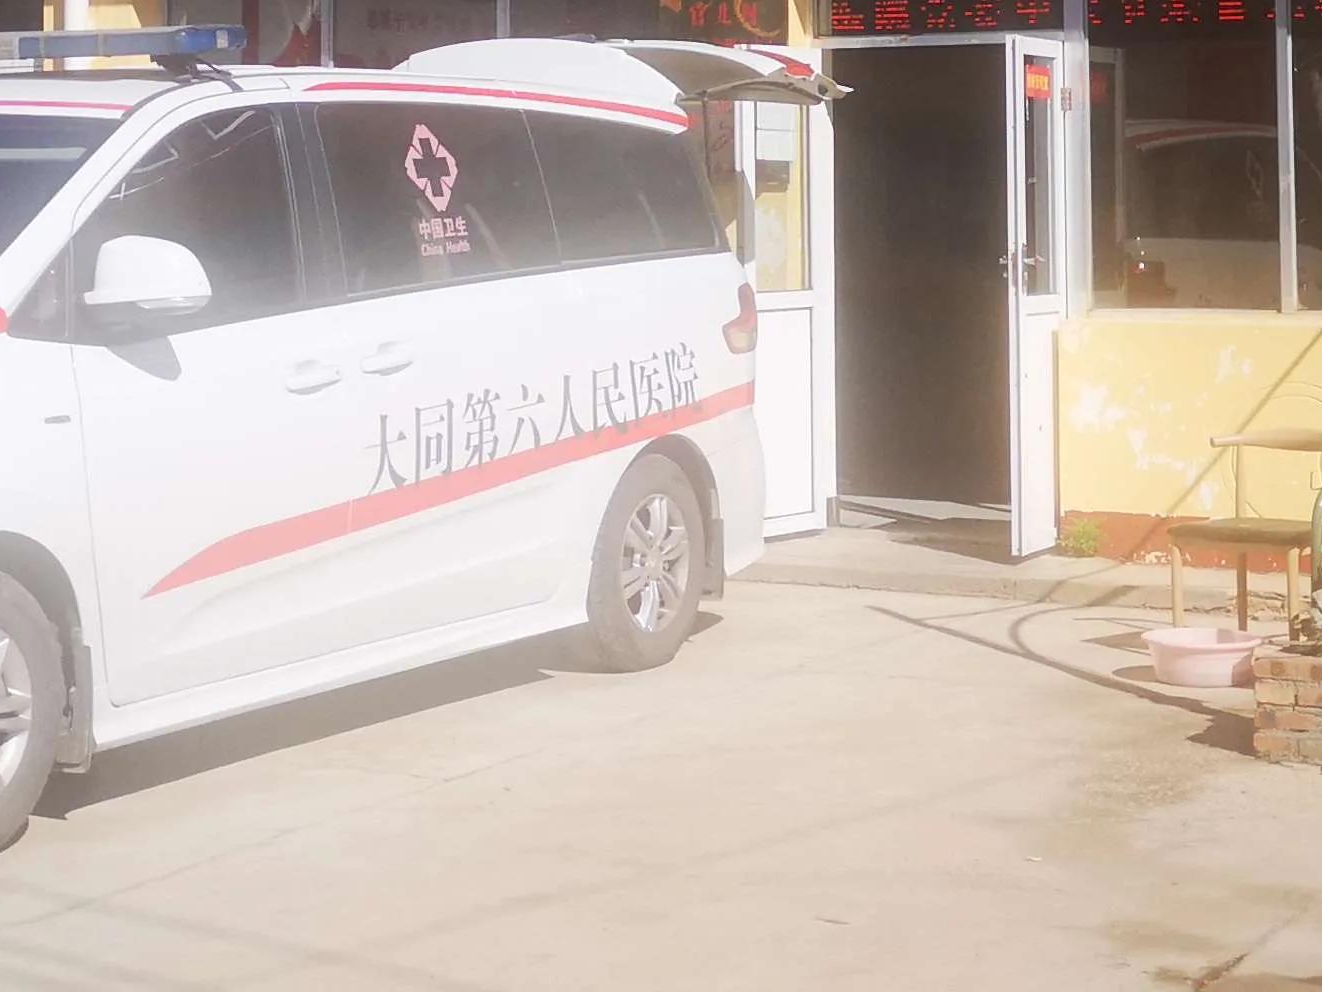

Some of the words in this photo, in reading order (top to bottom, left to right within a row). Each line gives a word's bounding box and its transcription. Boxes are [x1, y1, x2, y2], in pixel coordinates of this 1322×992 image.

[419, 215, 469, 239] 中国卫生
[364, 342, 700, 495] 大同第六人民医院
